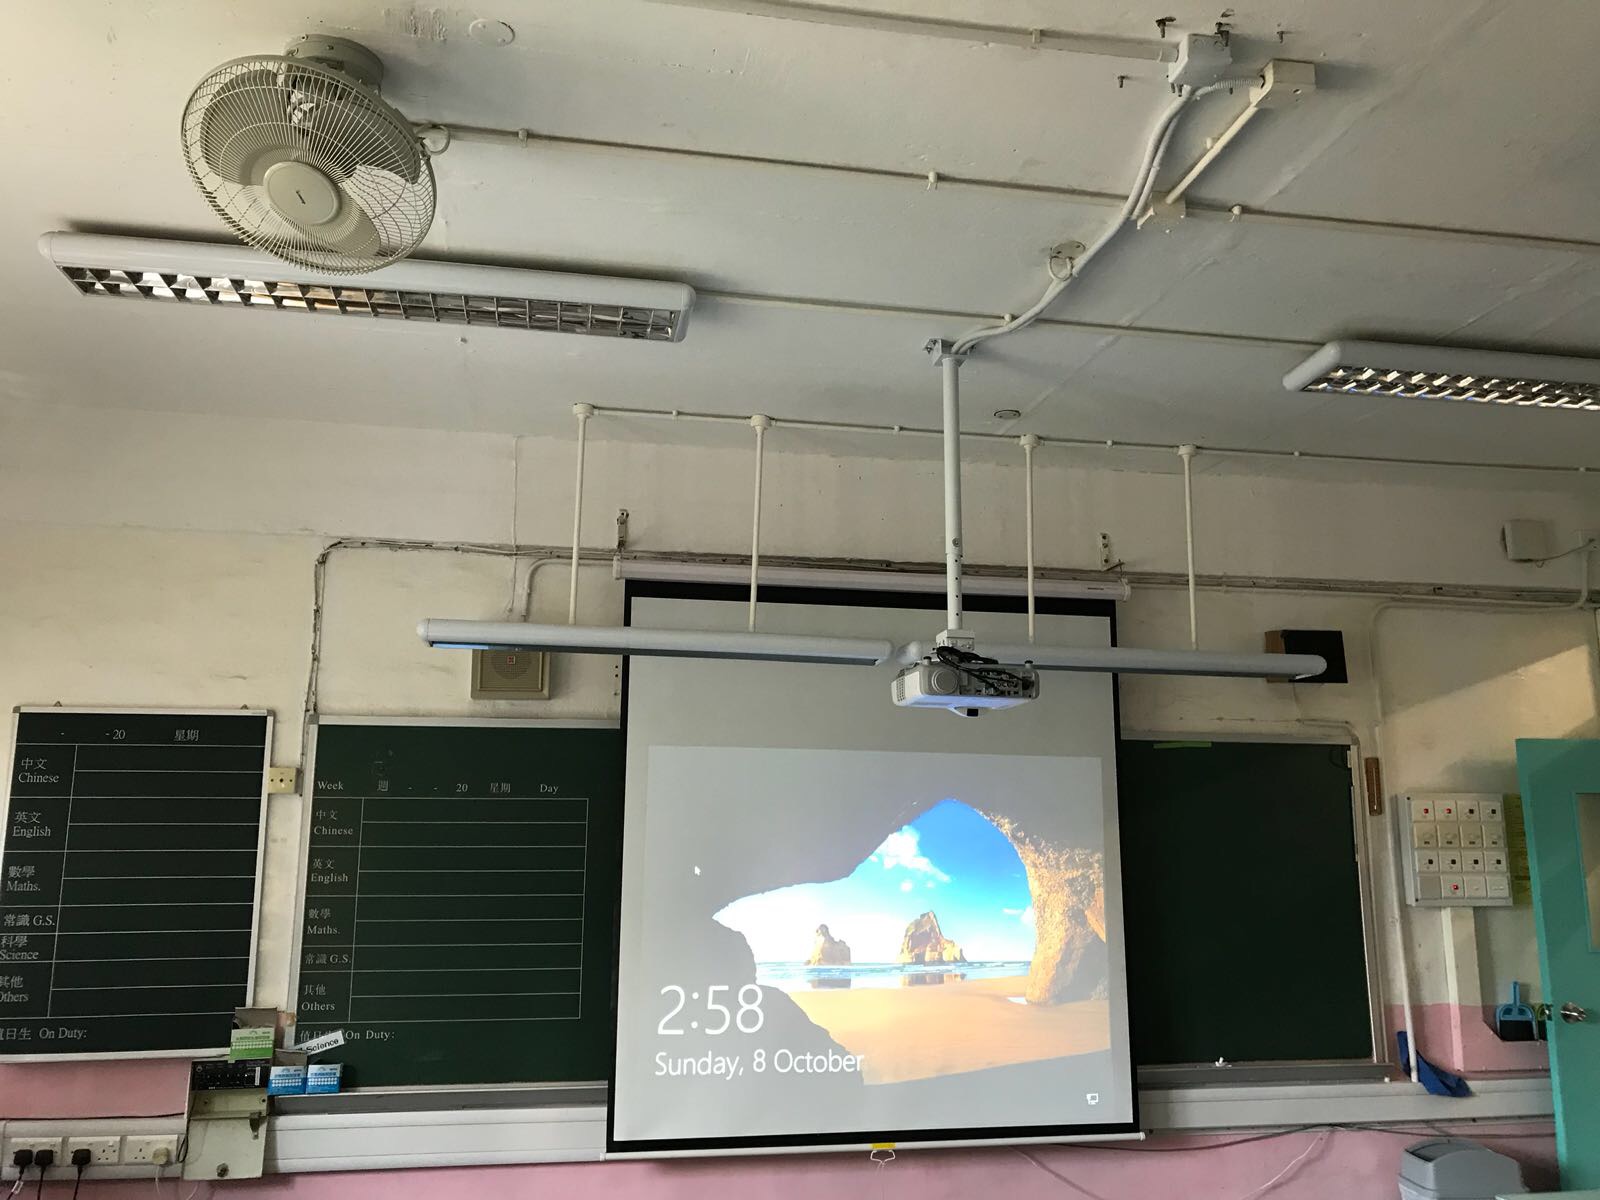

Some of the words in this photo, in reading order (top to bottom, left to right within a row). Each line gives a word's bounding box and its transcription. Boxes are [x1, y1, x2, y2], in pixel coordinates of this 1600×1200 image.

[174, 729, 199, 741] 星期
[21, 758, 47, 769] 中文
[19, 773, 59, 782] Chinese
[318, 781, 343, 790] Week
[377, 780, 388, 791] 週
[456, 784, 468, 792] 20
[490, 783, 510, 793] 星期
[540, 784, 558, 794] Day
[15, 812, 41, 823] 英文
[316, 810, 337, 820] 中文
[12, 826, 51, 838] English
[314, 826, 353, 835] Chinese
[313, 859, 334, 869] 英文
[8, 866, 35, 878] 數學
[311, 873, 348, 884] English
[6, 881, 40, 891] Maths.
[309, 908, 330, 919] 數學
[4, 914, 29, 926] 常識
[33, 915, 55, 926] G.S.
[307, 925, 340, 934] Maths.
[1, 936, 27, 948] 科學
[0, 949, 39, 960] Science
[305, 953, 327, 964] 常識
[330, 954, 351, 963] G.S.
[0, 976, 23, 988] 其他
[304, 984, 326, 995] 其他
[302, 1002, 335, 1010] Others
[656, 984, 765, 1036] 2:58
[39, 1028, 54, 1039] On
[58, 1028, 86, 1039] Duty:
[346, 1031, 360, 1039] On
[366, 1030, 394, 1041] Duty:
[306, 1038, 339, 1052] Science
[654, 1051, 744, 1081] Sunday,
[752, 1050, 766, 1074] 8
[773, 1049, 864, 1074] October
